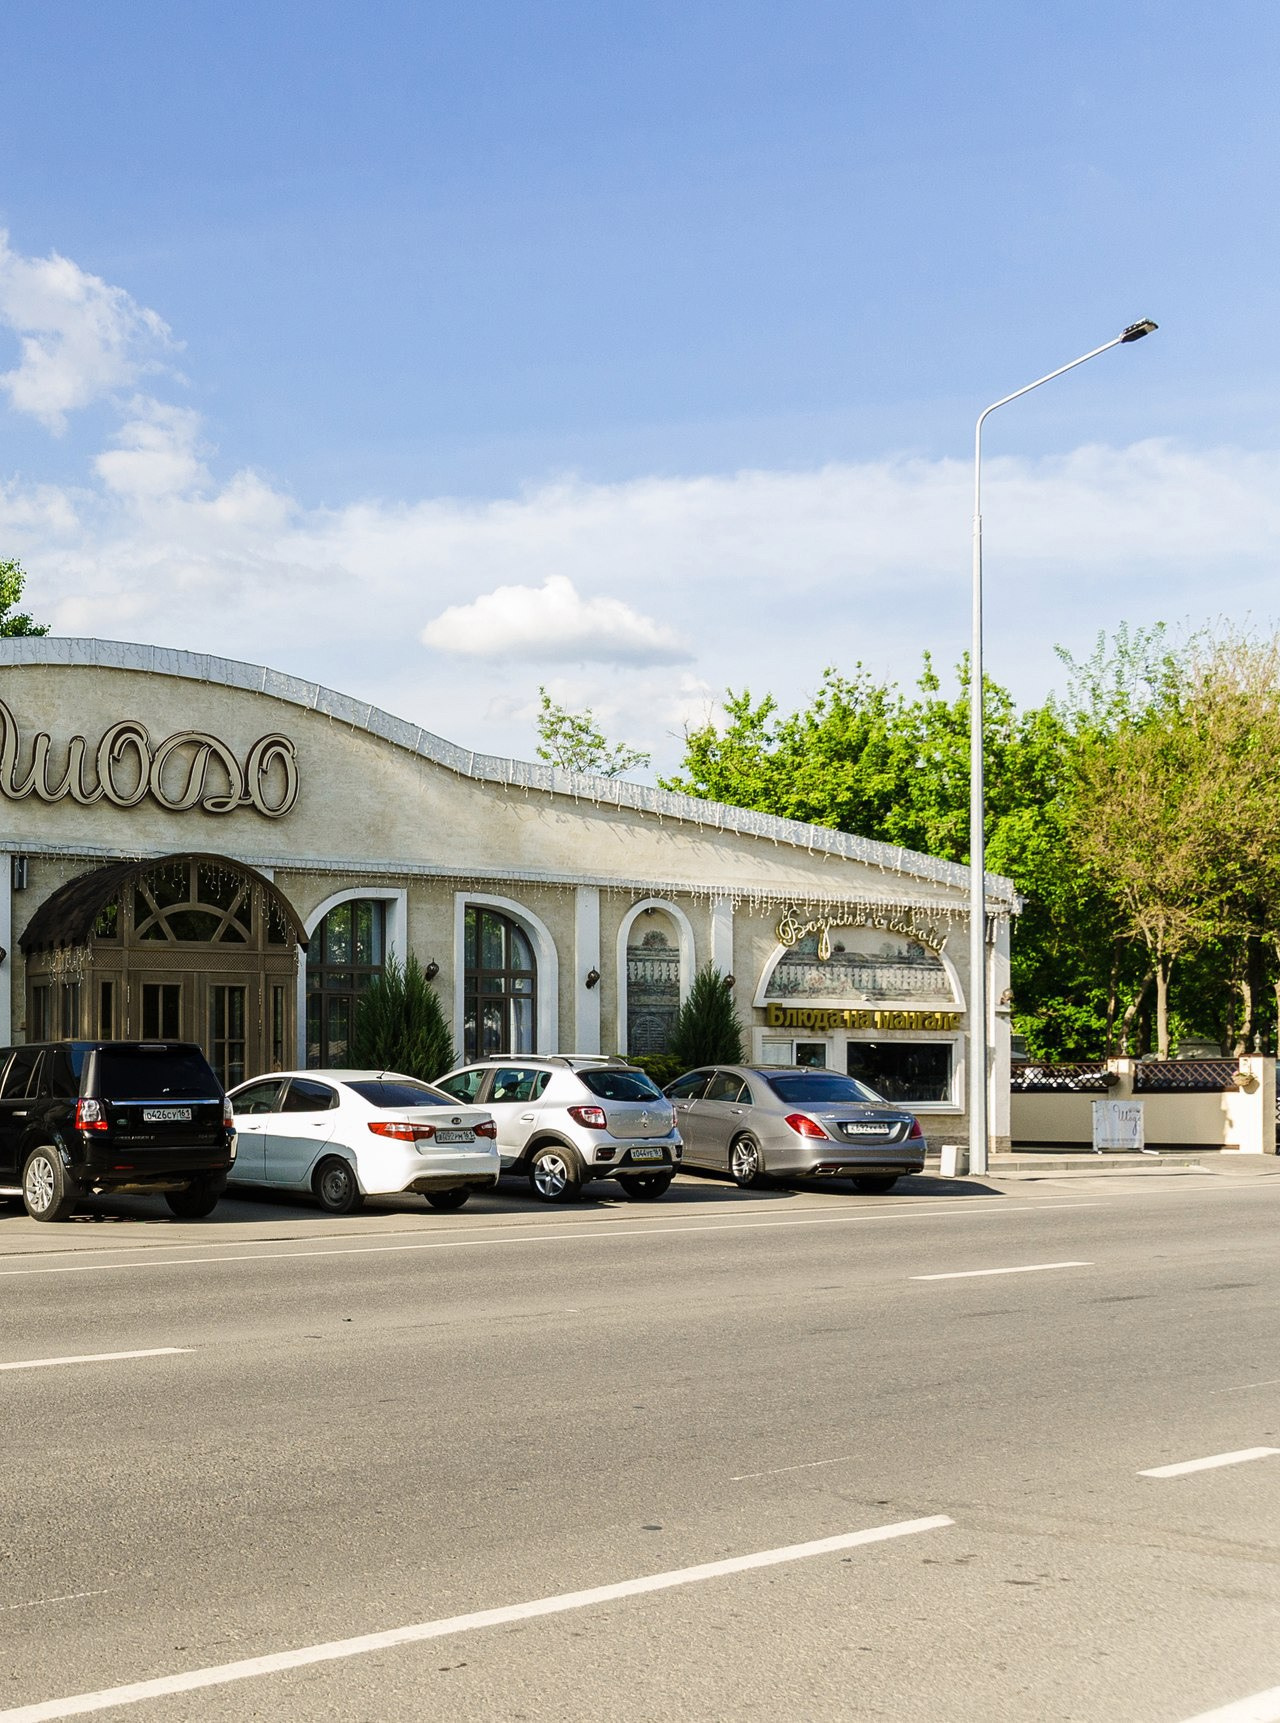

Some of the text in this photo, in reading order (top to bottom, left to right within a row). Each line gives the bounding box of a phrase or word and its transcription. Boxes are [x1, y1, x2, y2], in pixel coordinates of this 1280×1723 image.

[767, 1003, 961, 1031] Блюда на мангале
